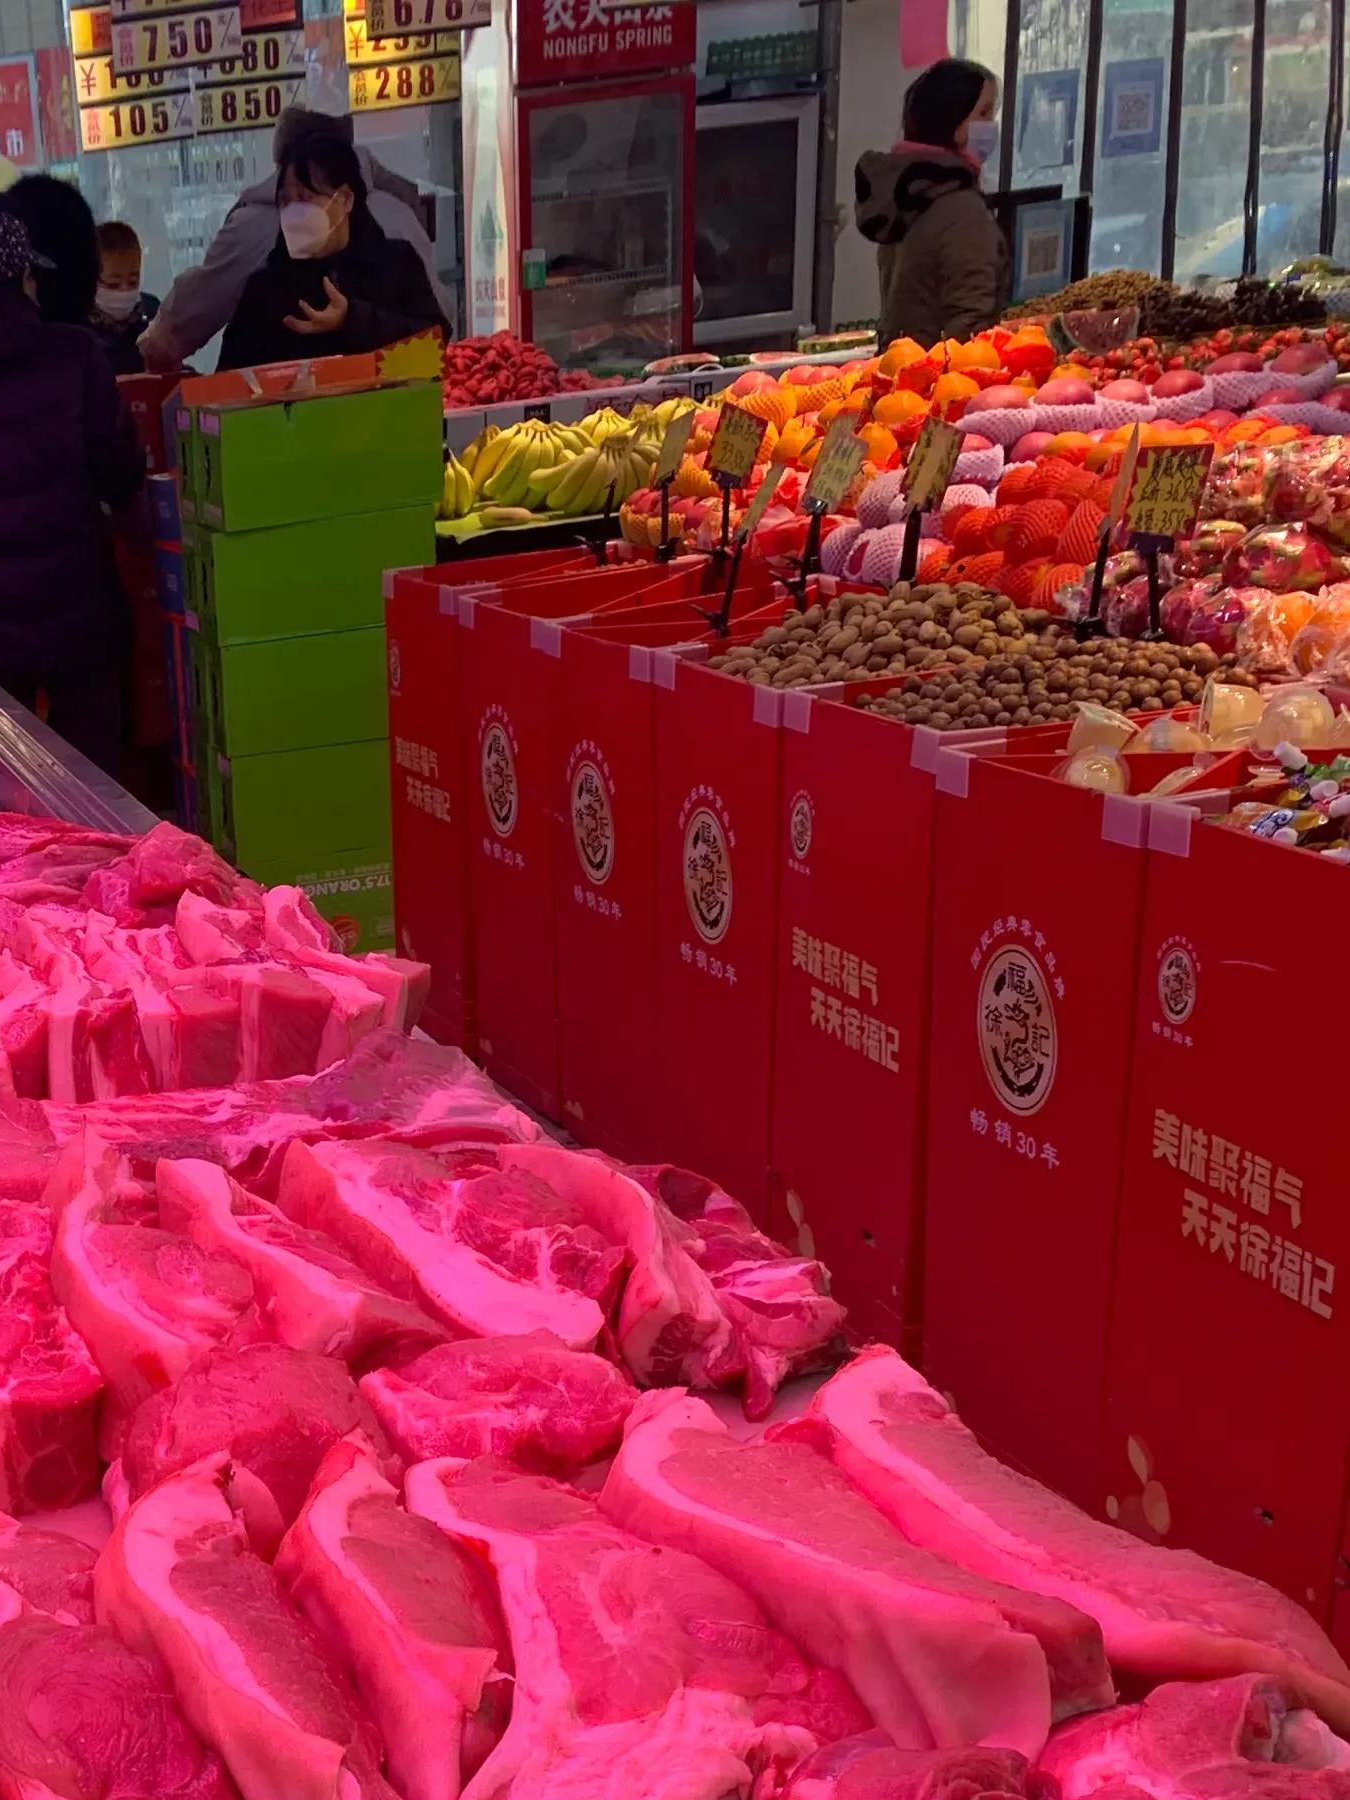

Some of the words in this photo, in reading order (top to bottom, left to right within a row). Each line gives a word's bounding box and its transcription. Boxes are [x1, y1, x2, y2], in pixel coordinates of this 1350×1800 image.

[543, 32, 608, 59] NONGFU
[615, 24, 672, 50] SPRING
[792, 926, 879, 1007] 美味聚福气
[810, 986, 899, 1074] 天天徐福记
[970, 1107, 1060, 1169] 畅销30年
[1152, 1108, 1303, 1230] 美味聚福气
[1181, 1187, 1336, 1320] 天天徐福记
